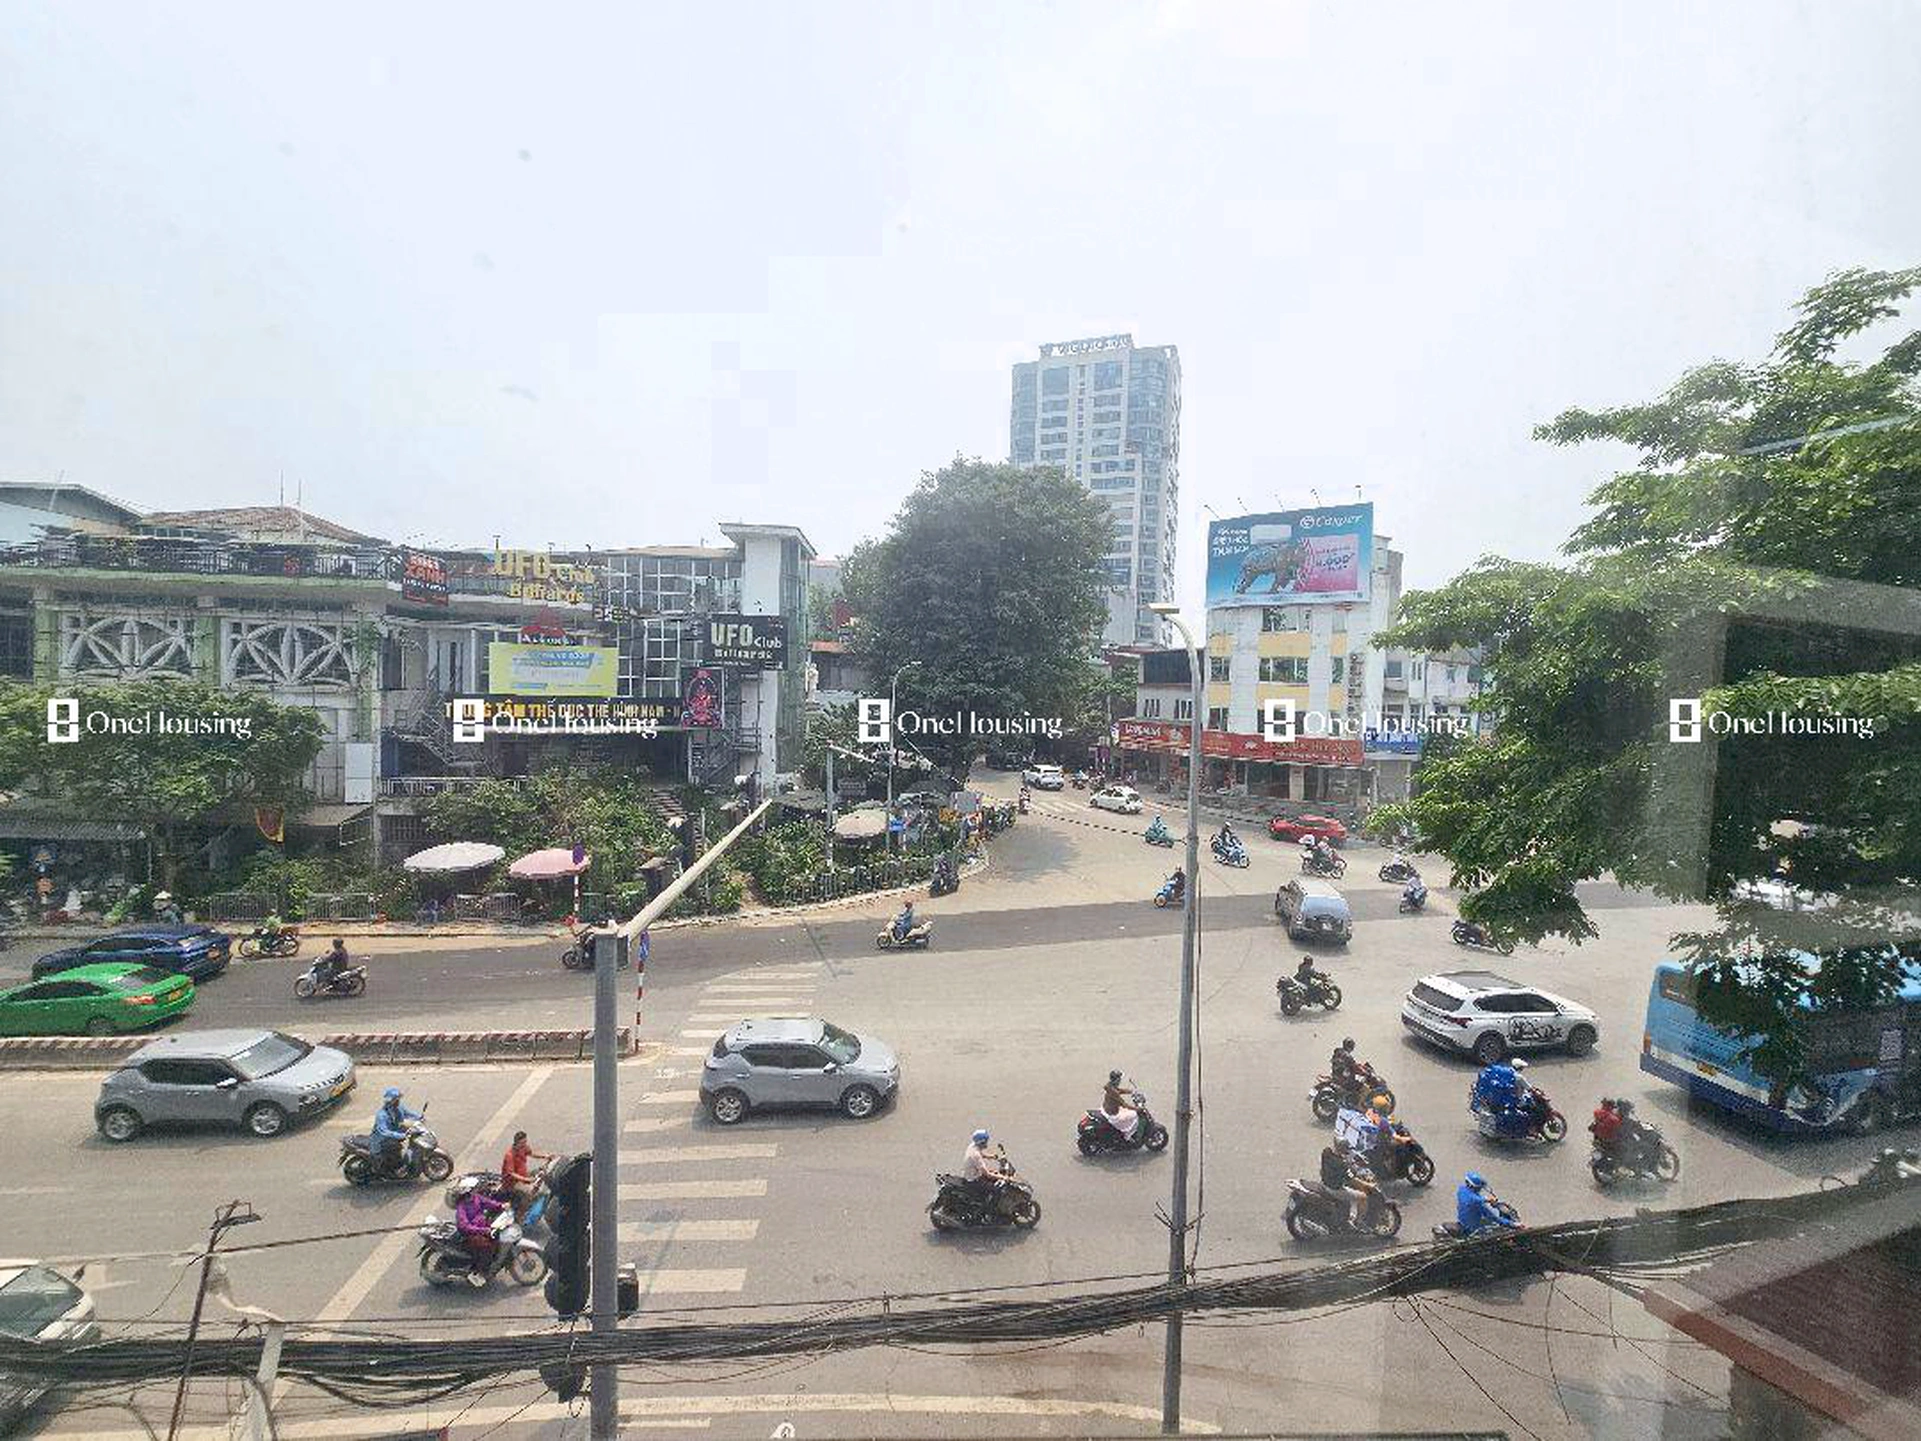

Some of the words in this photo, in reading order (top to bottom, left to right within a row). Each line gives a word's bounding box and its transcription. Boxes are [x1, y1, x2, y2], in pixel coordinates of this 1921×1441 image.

[495, 550, 551, 578] UFO
[711, 622, 753, 647] UFO
[754, 636, 783, 649] Club
